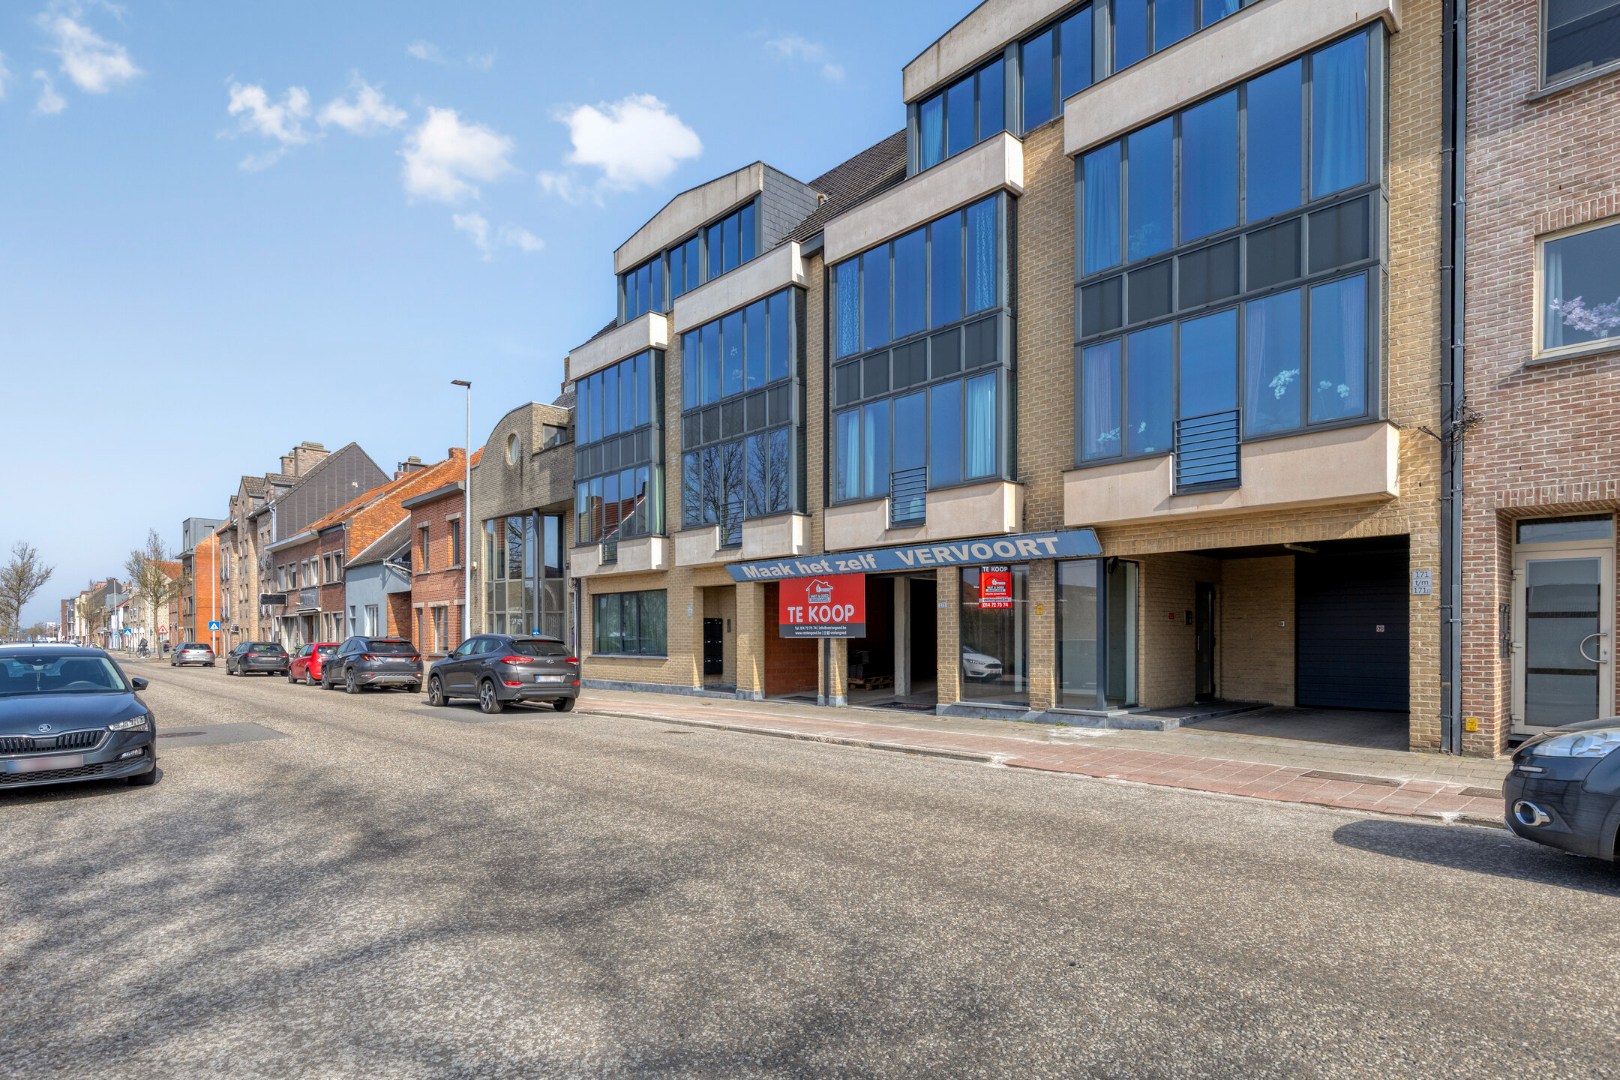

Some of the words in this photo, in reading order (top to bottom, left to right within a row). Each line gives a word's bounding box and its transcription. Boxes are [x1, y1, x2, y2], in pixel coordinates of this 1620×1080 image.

[741, 562, 795, 578] Maak
[795, 559, 833, 574] het
[836, 554, 877, 571] zelf
[895, 537, 1059, 566] VERVOORT
[787, 606, 804, 623] TE
[808, 604, 855, 623] KOOP
